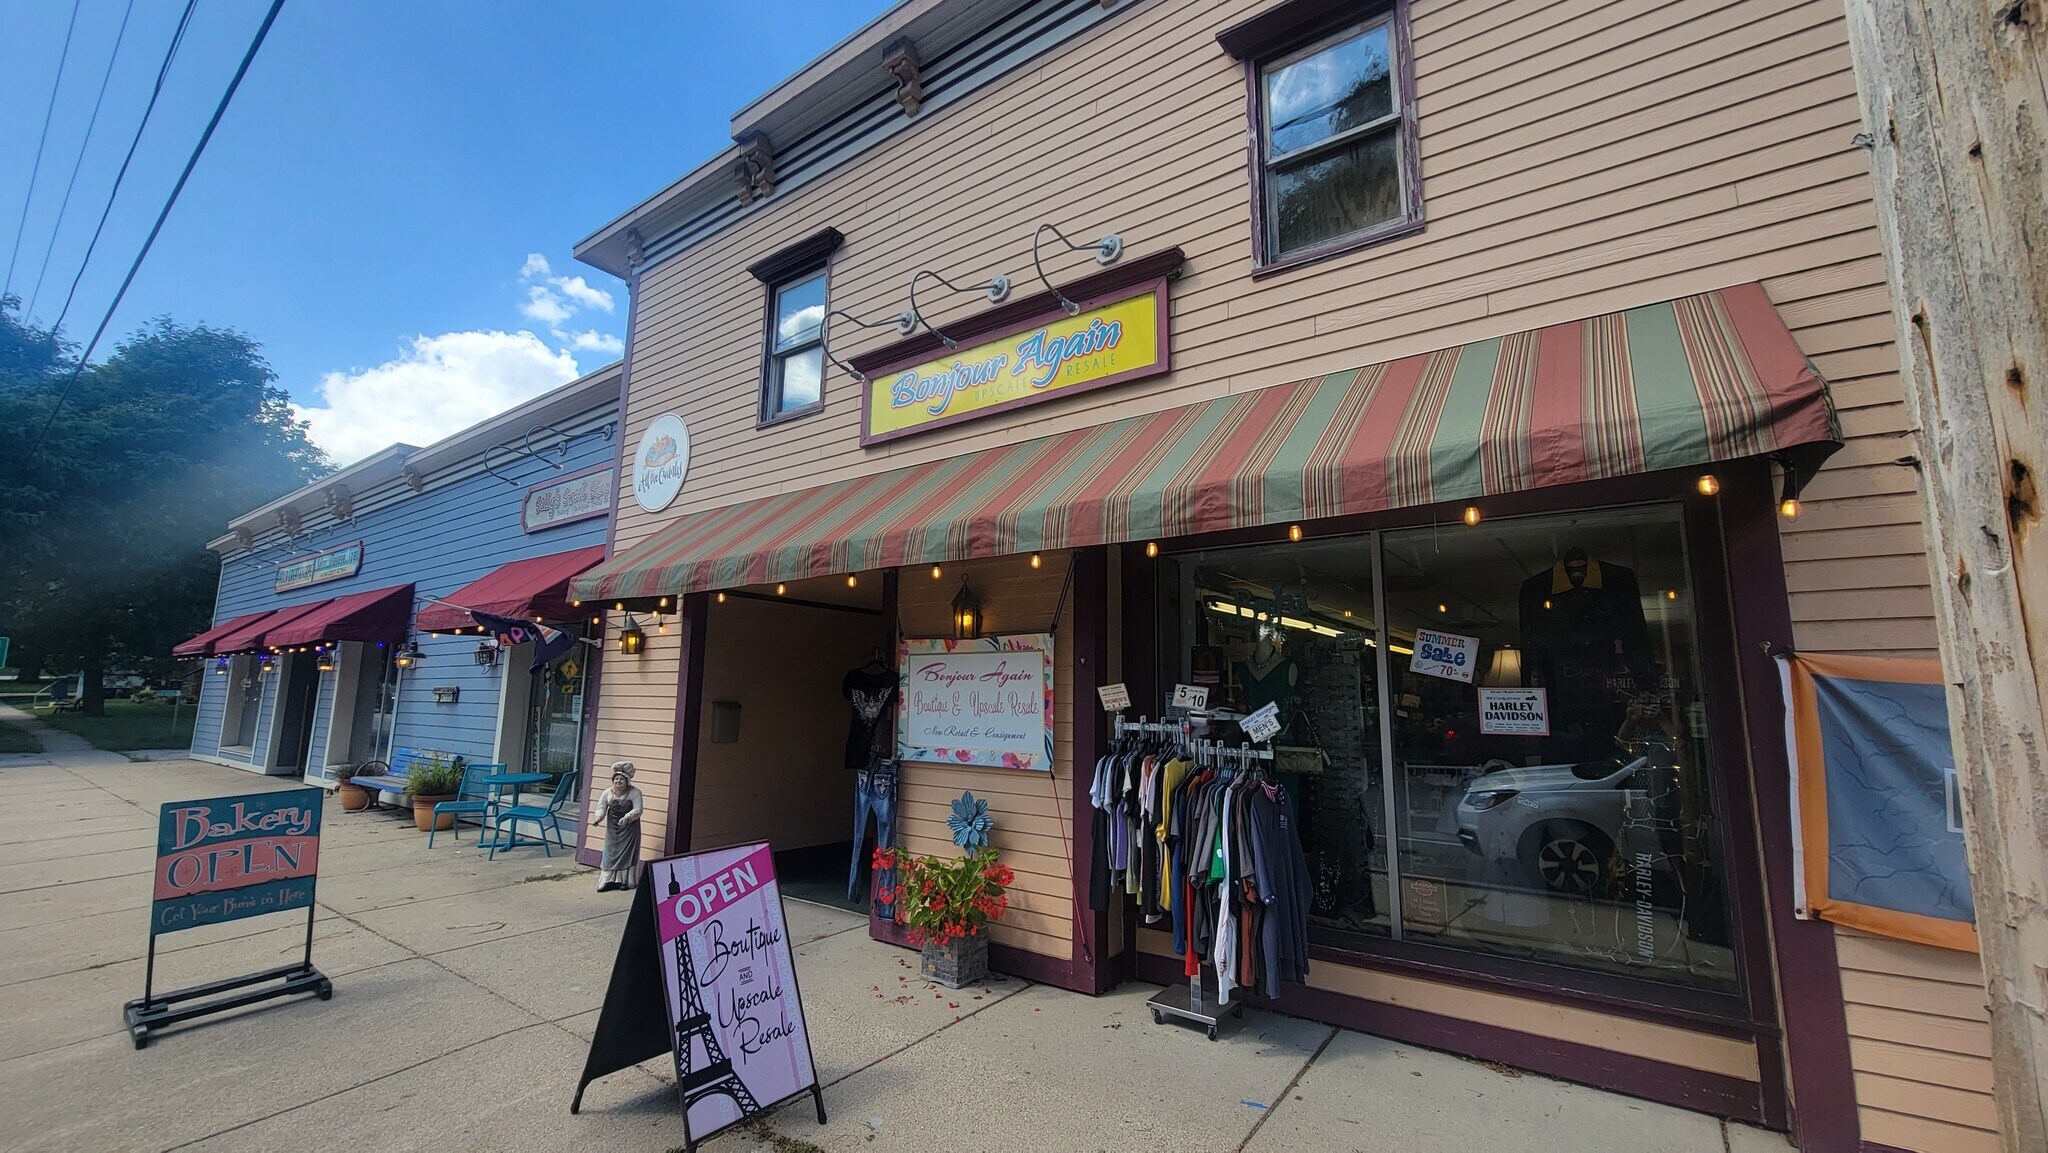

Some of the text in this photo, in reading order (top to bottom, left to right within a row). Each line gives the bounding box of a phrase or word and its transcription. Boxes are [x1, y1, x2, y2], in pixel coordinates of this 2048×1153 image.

[890, 317, 1122, 416] Bonjour Again
[974, 352, 1116, 402] UPSCALE RESALE
[1419, 631, 1465, 649] SUMMER
[1420, 643, 1466, 667] Sale
[916, 660, 1034, 688] Bonjour Again
[914, 689, 1040, 719] Boutique & Upscale Resale
[1484, 711, 1544, 721] DAVIDSON
[1489, 701, 1534, 711] HARLEY
[943, 725, 969, 738] Retail
[970, 727, 980, 738] &
[982, 727, 1027, 742] Consignment
[1252, 718, 1275, 735] MEN'S
[169, 802, 313, 851] Bakery
[167, 840, 307, 889] OPEN
[160, 906, 185, 926] Get
[190, 902, 221, 921] Your
[260, 892, 274, 906] in
[278, 888, 306, 907] Here
[674, 860, 759, 925] OPEN
[1635, 852, 1655, 960] HARLEY-DAVIDSON
[700, 917, 782, 988] Boutique
[739, 970, 753, 982] AND
[717, 975, 784, 1029] Upscale
[733, 1011, 797, 1066] Resale
